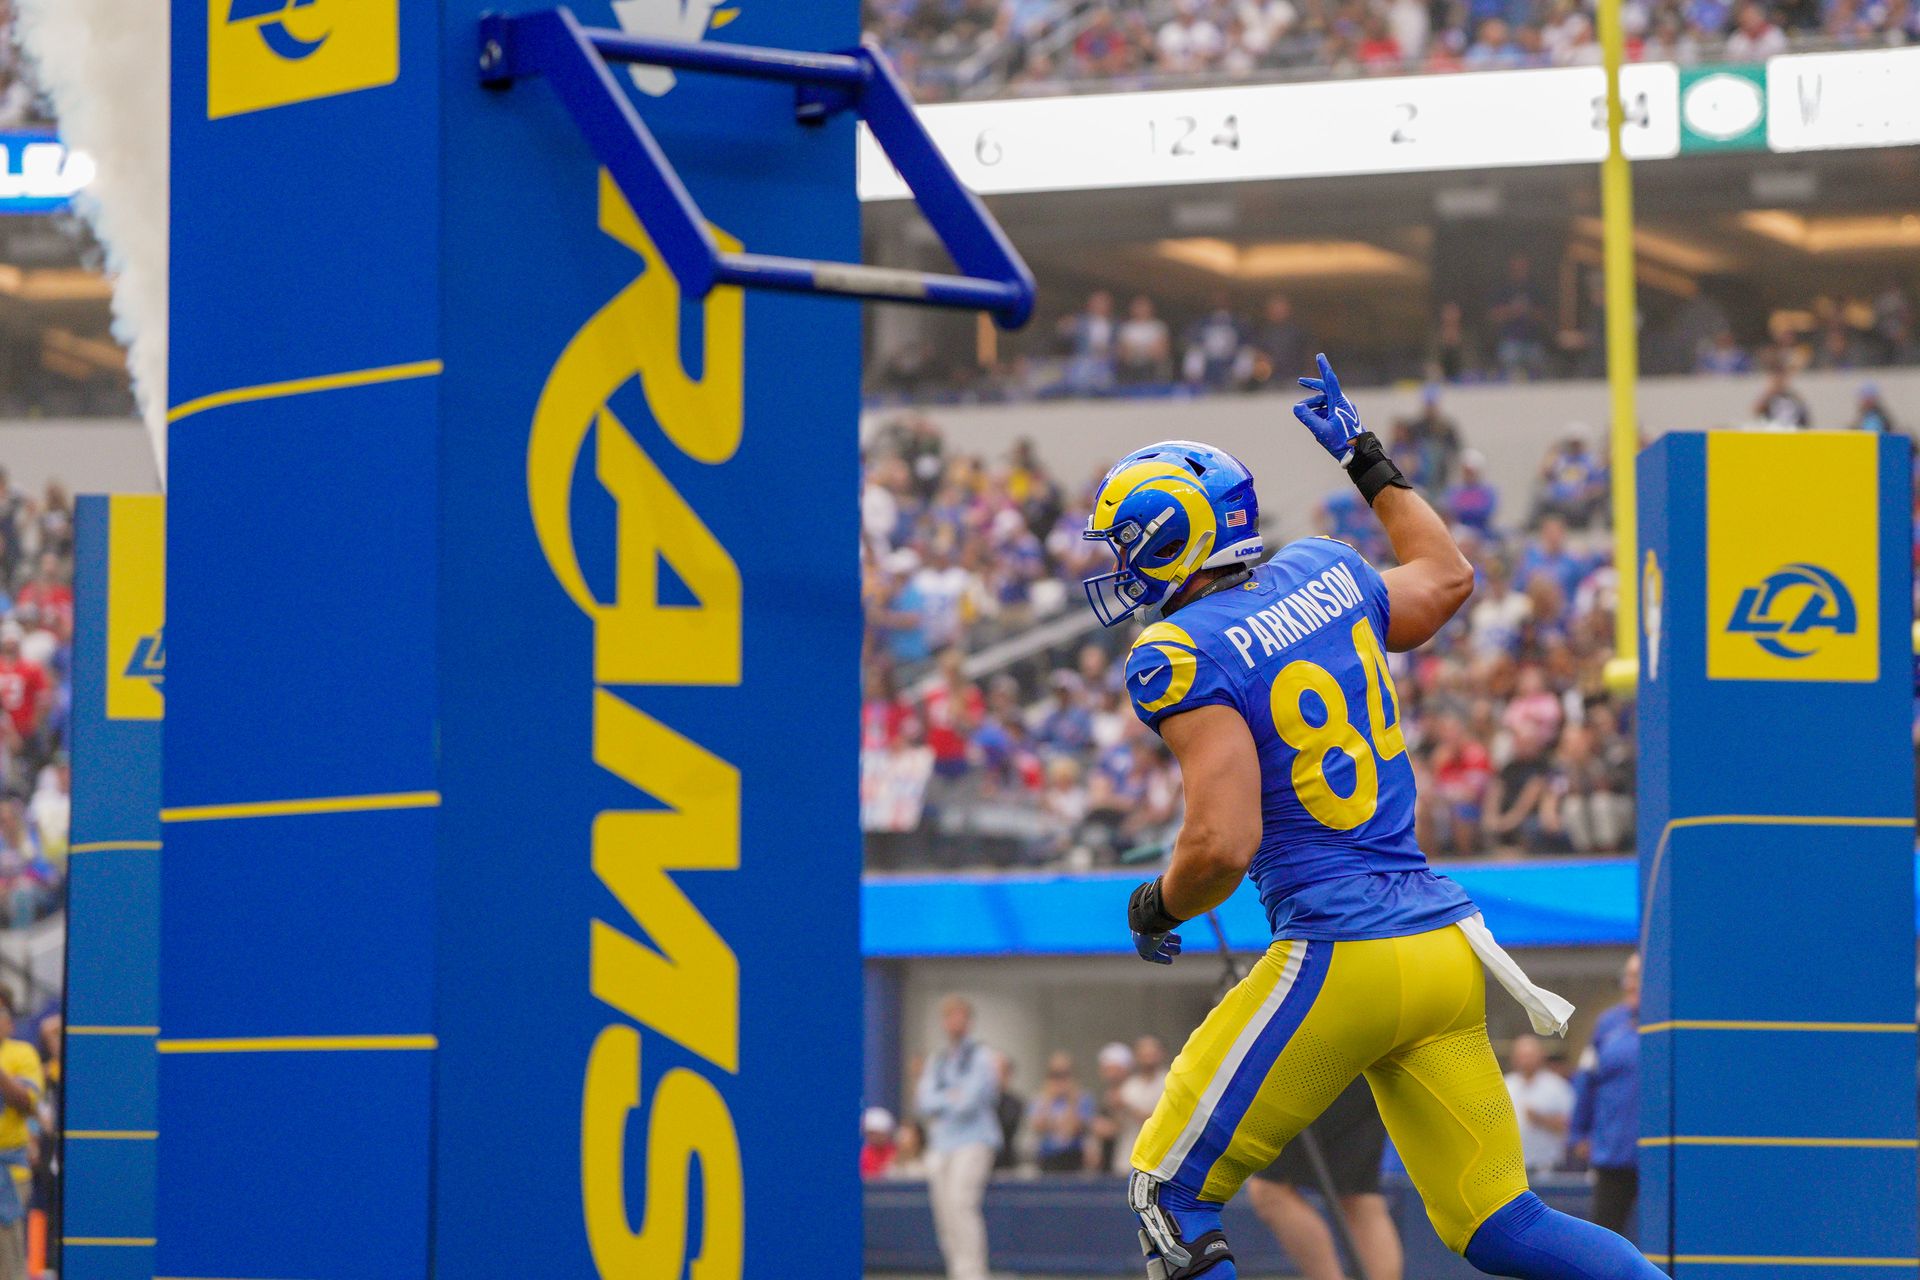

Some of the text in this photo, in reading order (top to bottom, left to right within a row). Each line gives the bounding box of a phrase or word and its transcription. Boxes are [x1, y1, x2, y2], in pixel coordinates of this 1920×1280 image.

[974, 127, 1003, 167] 6
[1148, 113, 1242, 158] 124
[1224, 562, 1366, 669] PARKINSON
[526, 164, 745, 1280] RAMS
[1270, 616, 1406, 832] 84
